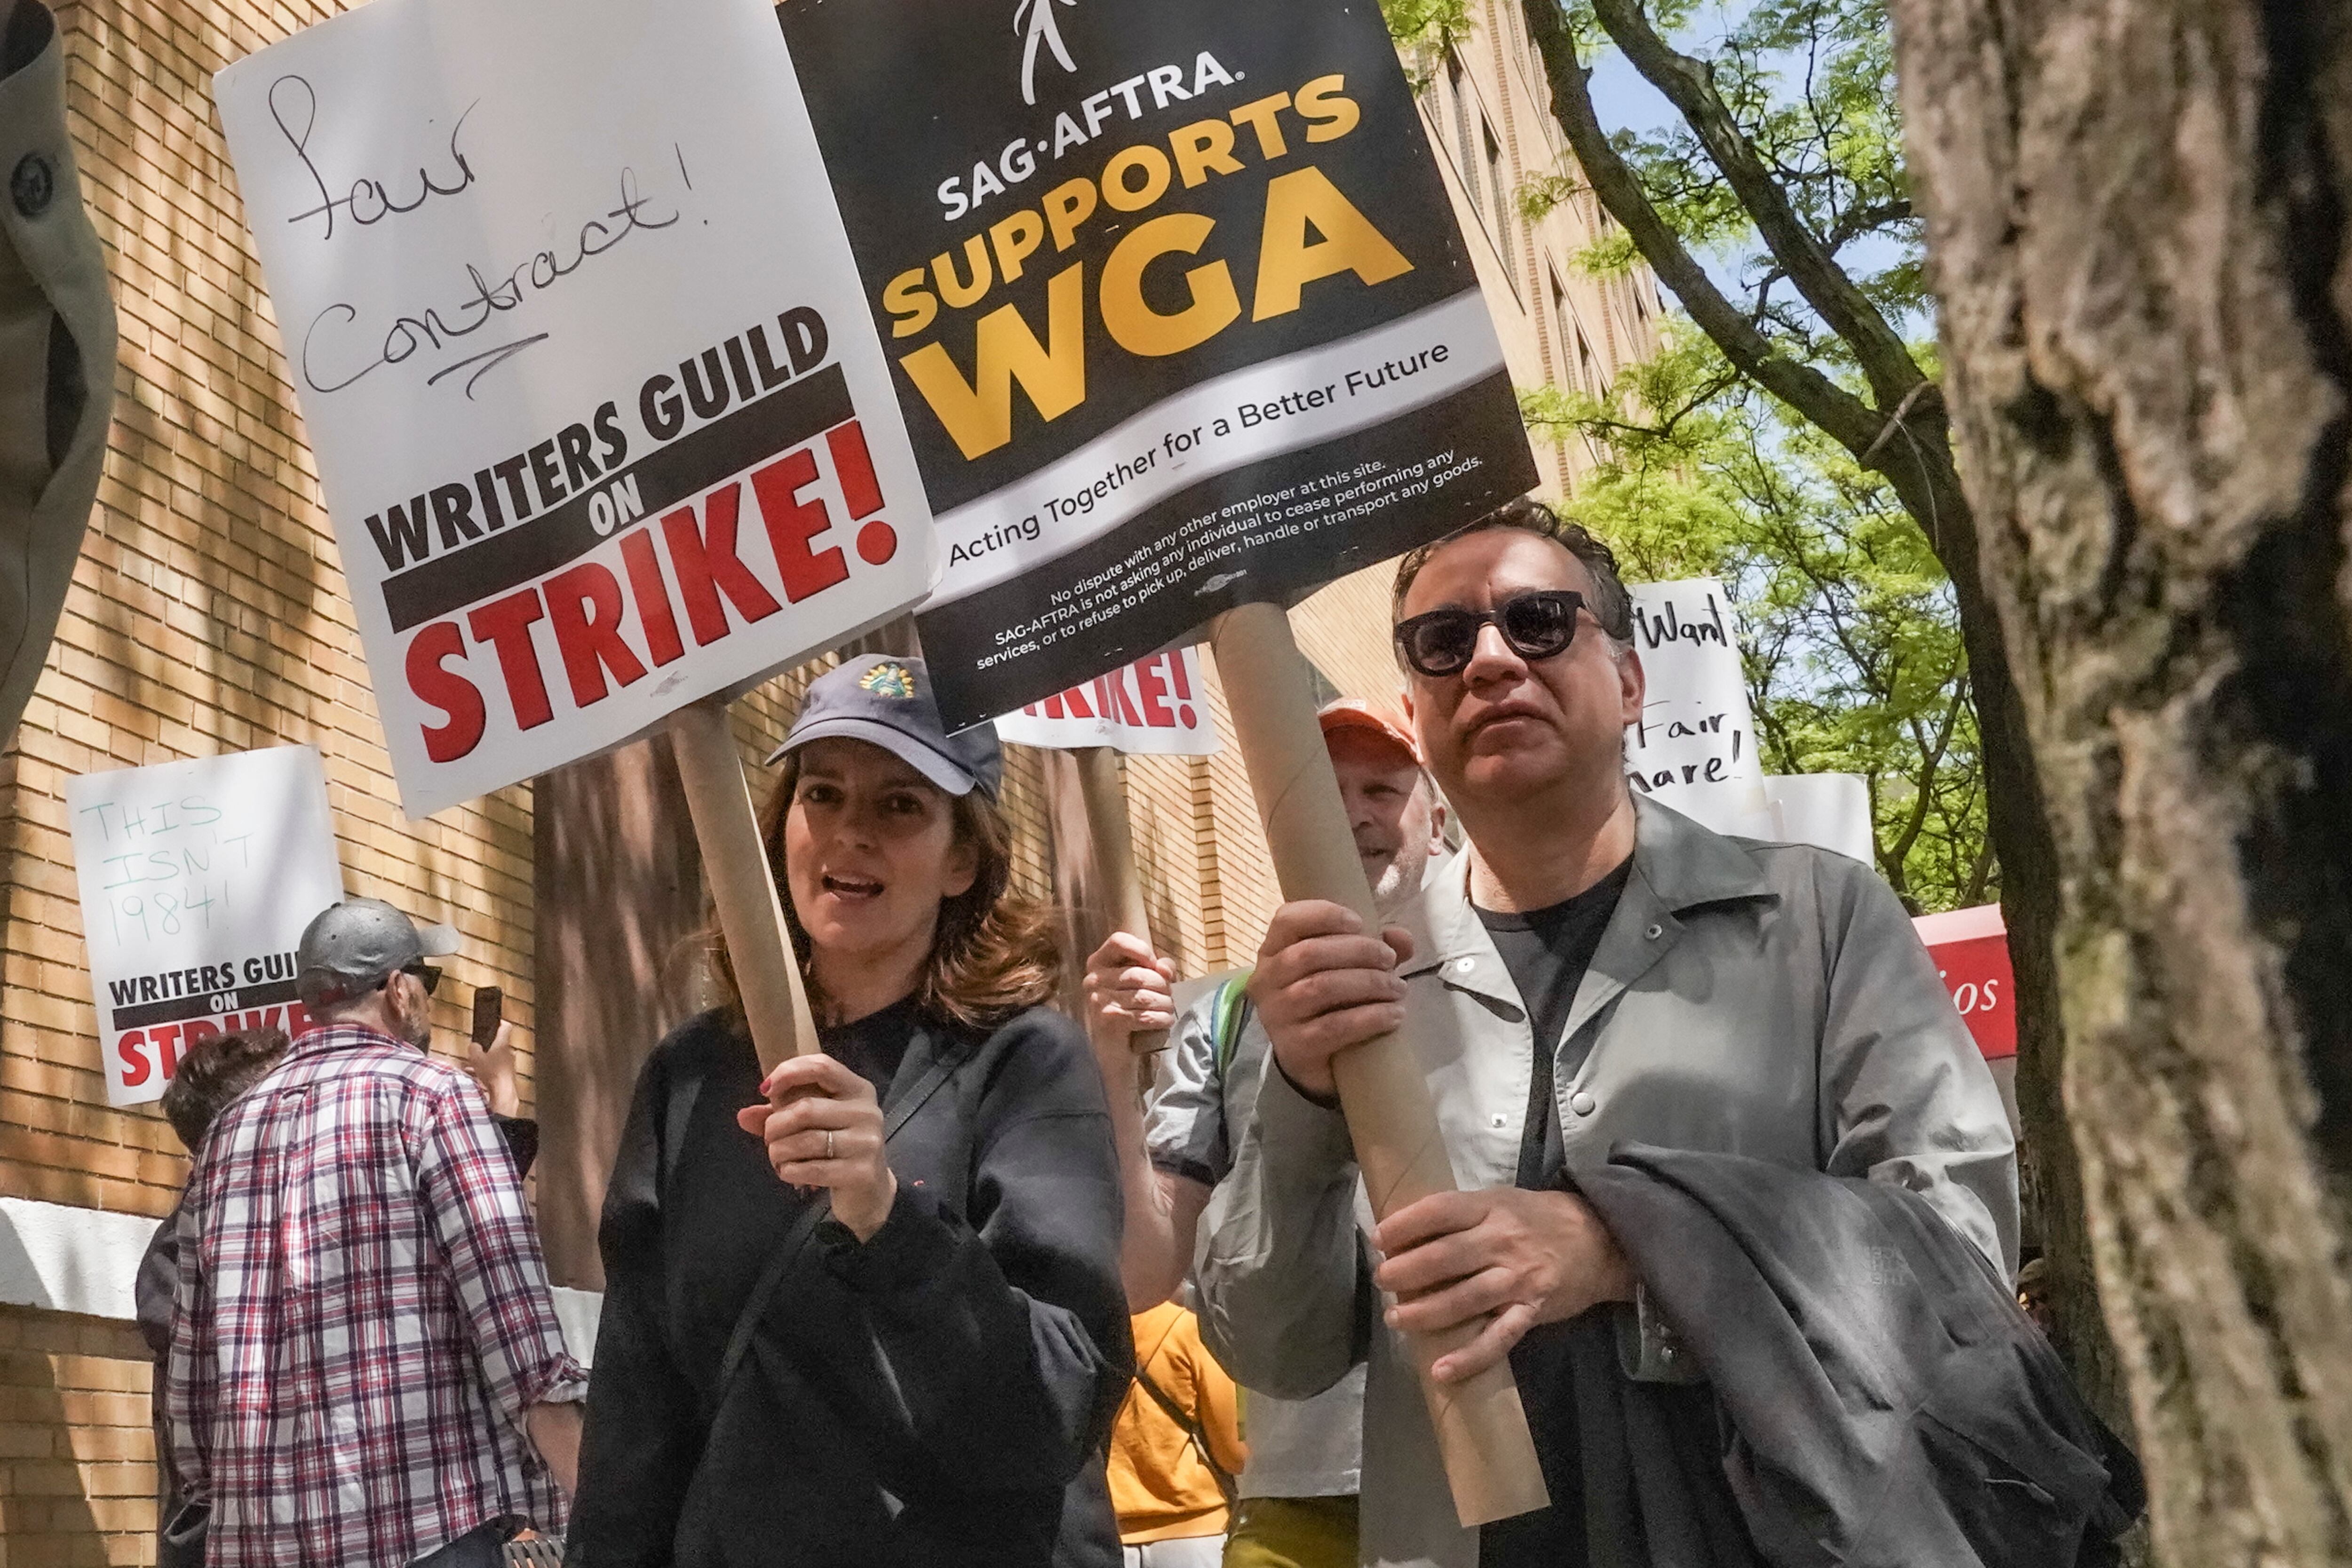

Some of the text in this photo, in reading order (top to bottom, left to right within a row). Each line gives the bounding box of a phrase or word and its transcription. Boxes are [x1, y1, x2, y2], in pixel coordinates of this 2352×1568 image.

[302, 142, 707, 392] Contract!
[882, 74, 1361, 338] SUPPORTS
[898, 165, 1415, 461] WGA
[365, 305, 829, 572] WRITERS GUILD
[588, 473, 645, 537] ON
[949, 343, 1449, 568] Acting Together for a Better Future
[404, 419, 898, 763] STRIKE!
[976, 639, 1041, 670] services,
[1042, 631, 1058, 645] or
[1060, 623, 1076, 638] to
[1079, 602, 1121, 630] refuse
[1122, 593, 1136, 608] to
[1138, 578, 1165, 604] pick
[1166, 567, 1187, 584] up,
[1188, 541, 1242, 571] deliver,
[1243, 524, 1300, 549] handle
[1303, 518, 1319, 533] or
[1323, 491, 1399, 525] transport
[1401, 479, 1430, 499] any
[1432, 456, 1483, 488] goods.
[995, 449, 1454, 645] SAG-AFTRA is not asking any individual to cease performing any
[1050, 461, 1386, 605] No dispute with any other employer at this site.
[1636, 593, 1728, 649] Want
[1637, 700, 1728, 749] Fair
[79, 795, 222, 842] THIS
[103, 828, 254, 890] ISN'T
[109, 879, 230, 947] 1984!
[109, 962, 236, 1006] WRITERS
[210, 992, 239, 1013] ON
